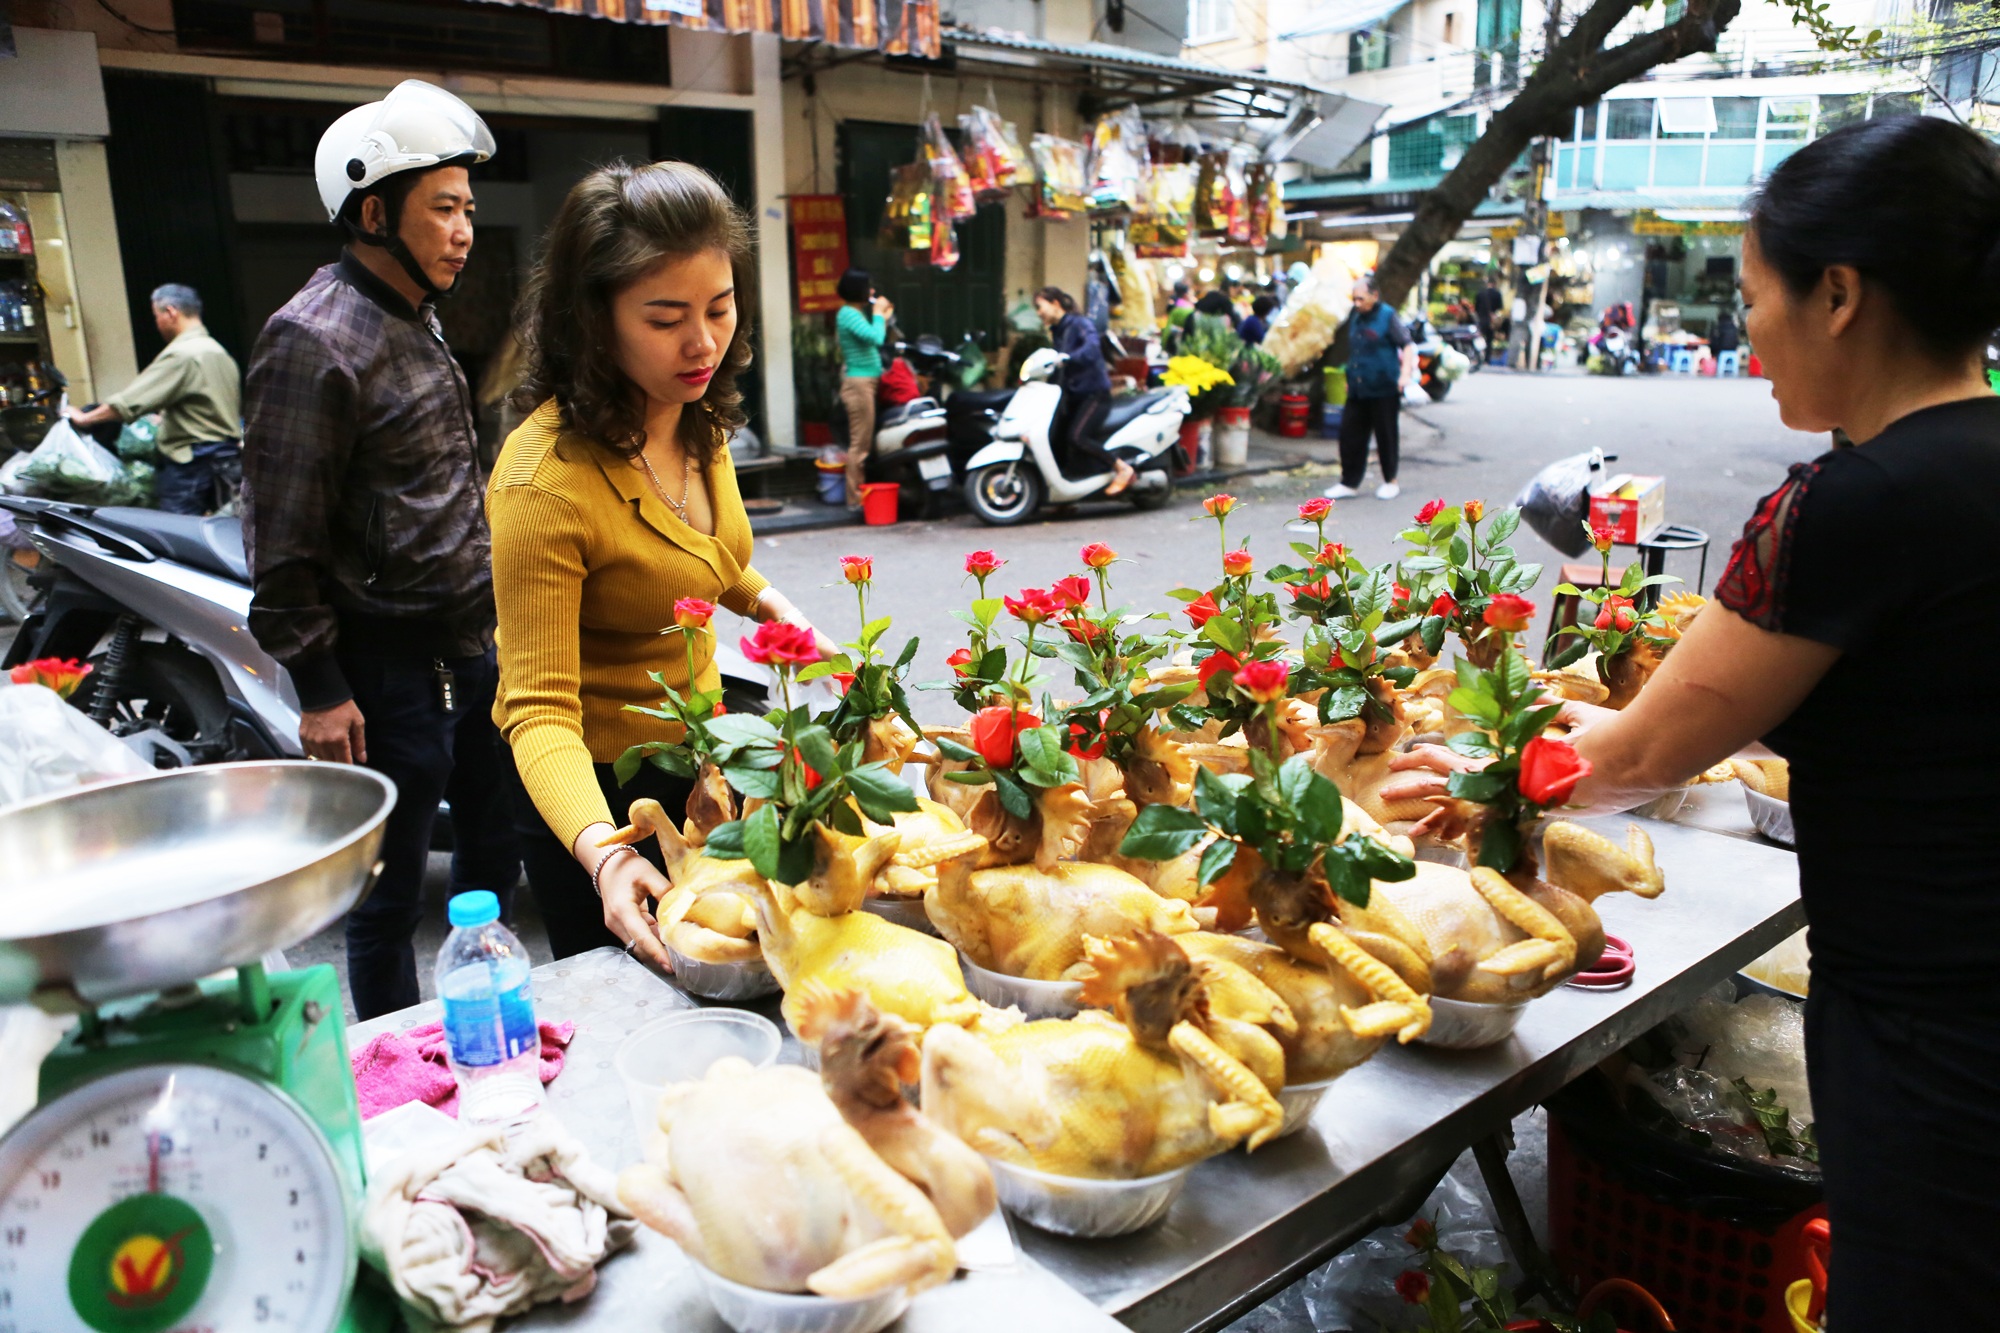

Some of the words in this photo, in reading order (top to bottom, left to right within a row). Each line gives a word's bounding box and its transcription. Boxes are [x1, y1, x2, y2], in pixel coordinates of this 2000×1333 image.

[257, 1143, 268, 1161] 2
[289, 1190, 299, 1206] 3
[255, 1295, 270, 1322] 5
